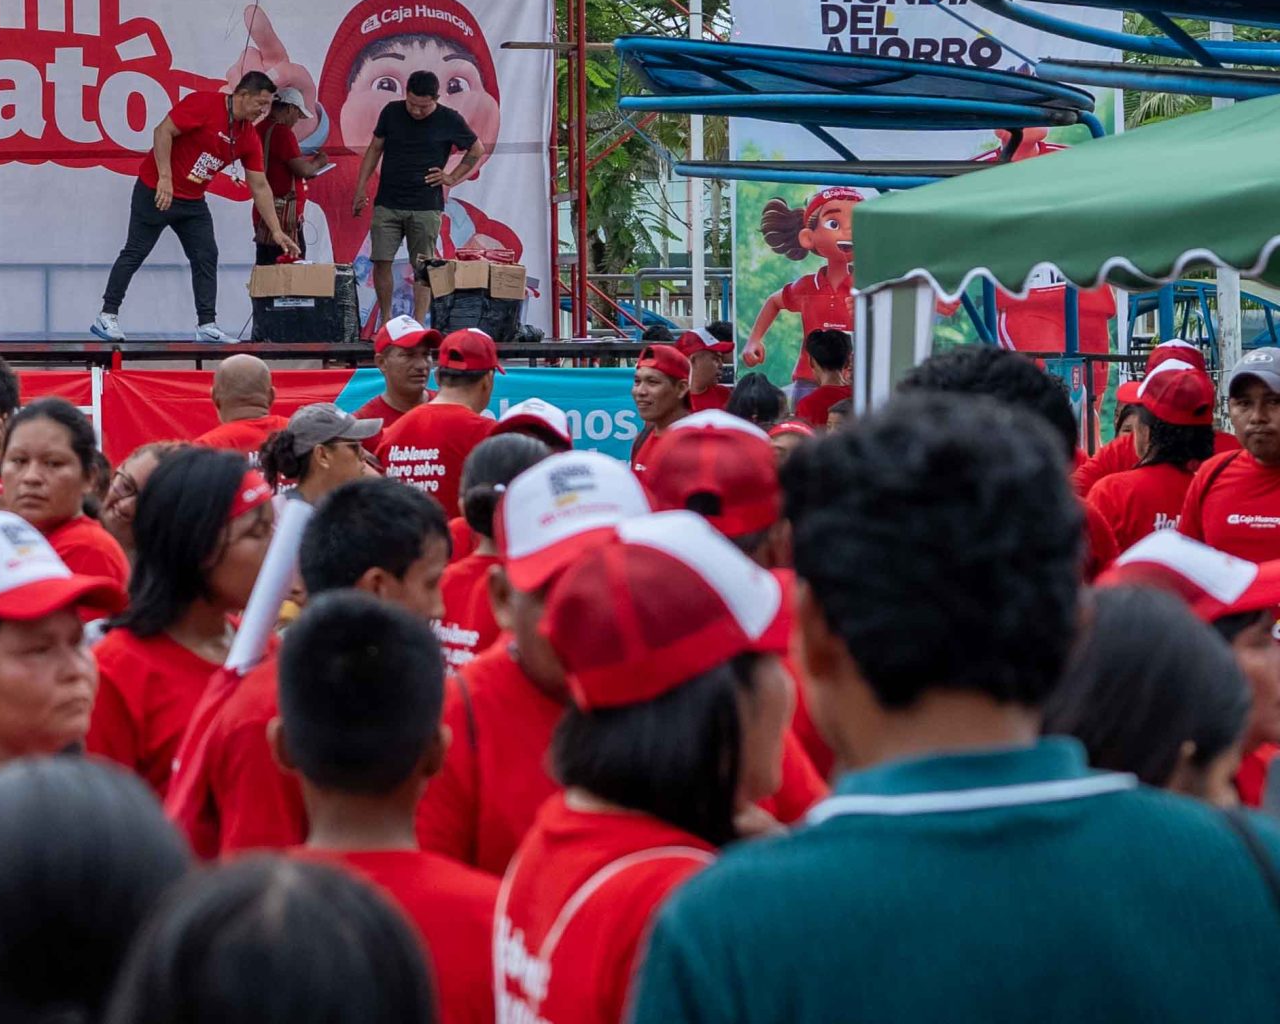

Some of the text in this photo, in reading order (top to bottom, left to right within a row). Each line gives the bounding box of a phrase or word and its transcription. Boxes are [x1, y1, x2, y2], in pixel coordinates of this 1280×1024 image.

[381, 5, 474, 36] Caja Huancayo
[821, 4, 899, 36] DEL
[389, 445, 439, 461] Hablemos
[413, 461, 446, 476] sobre
